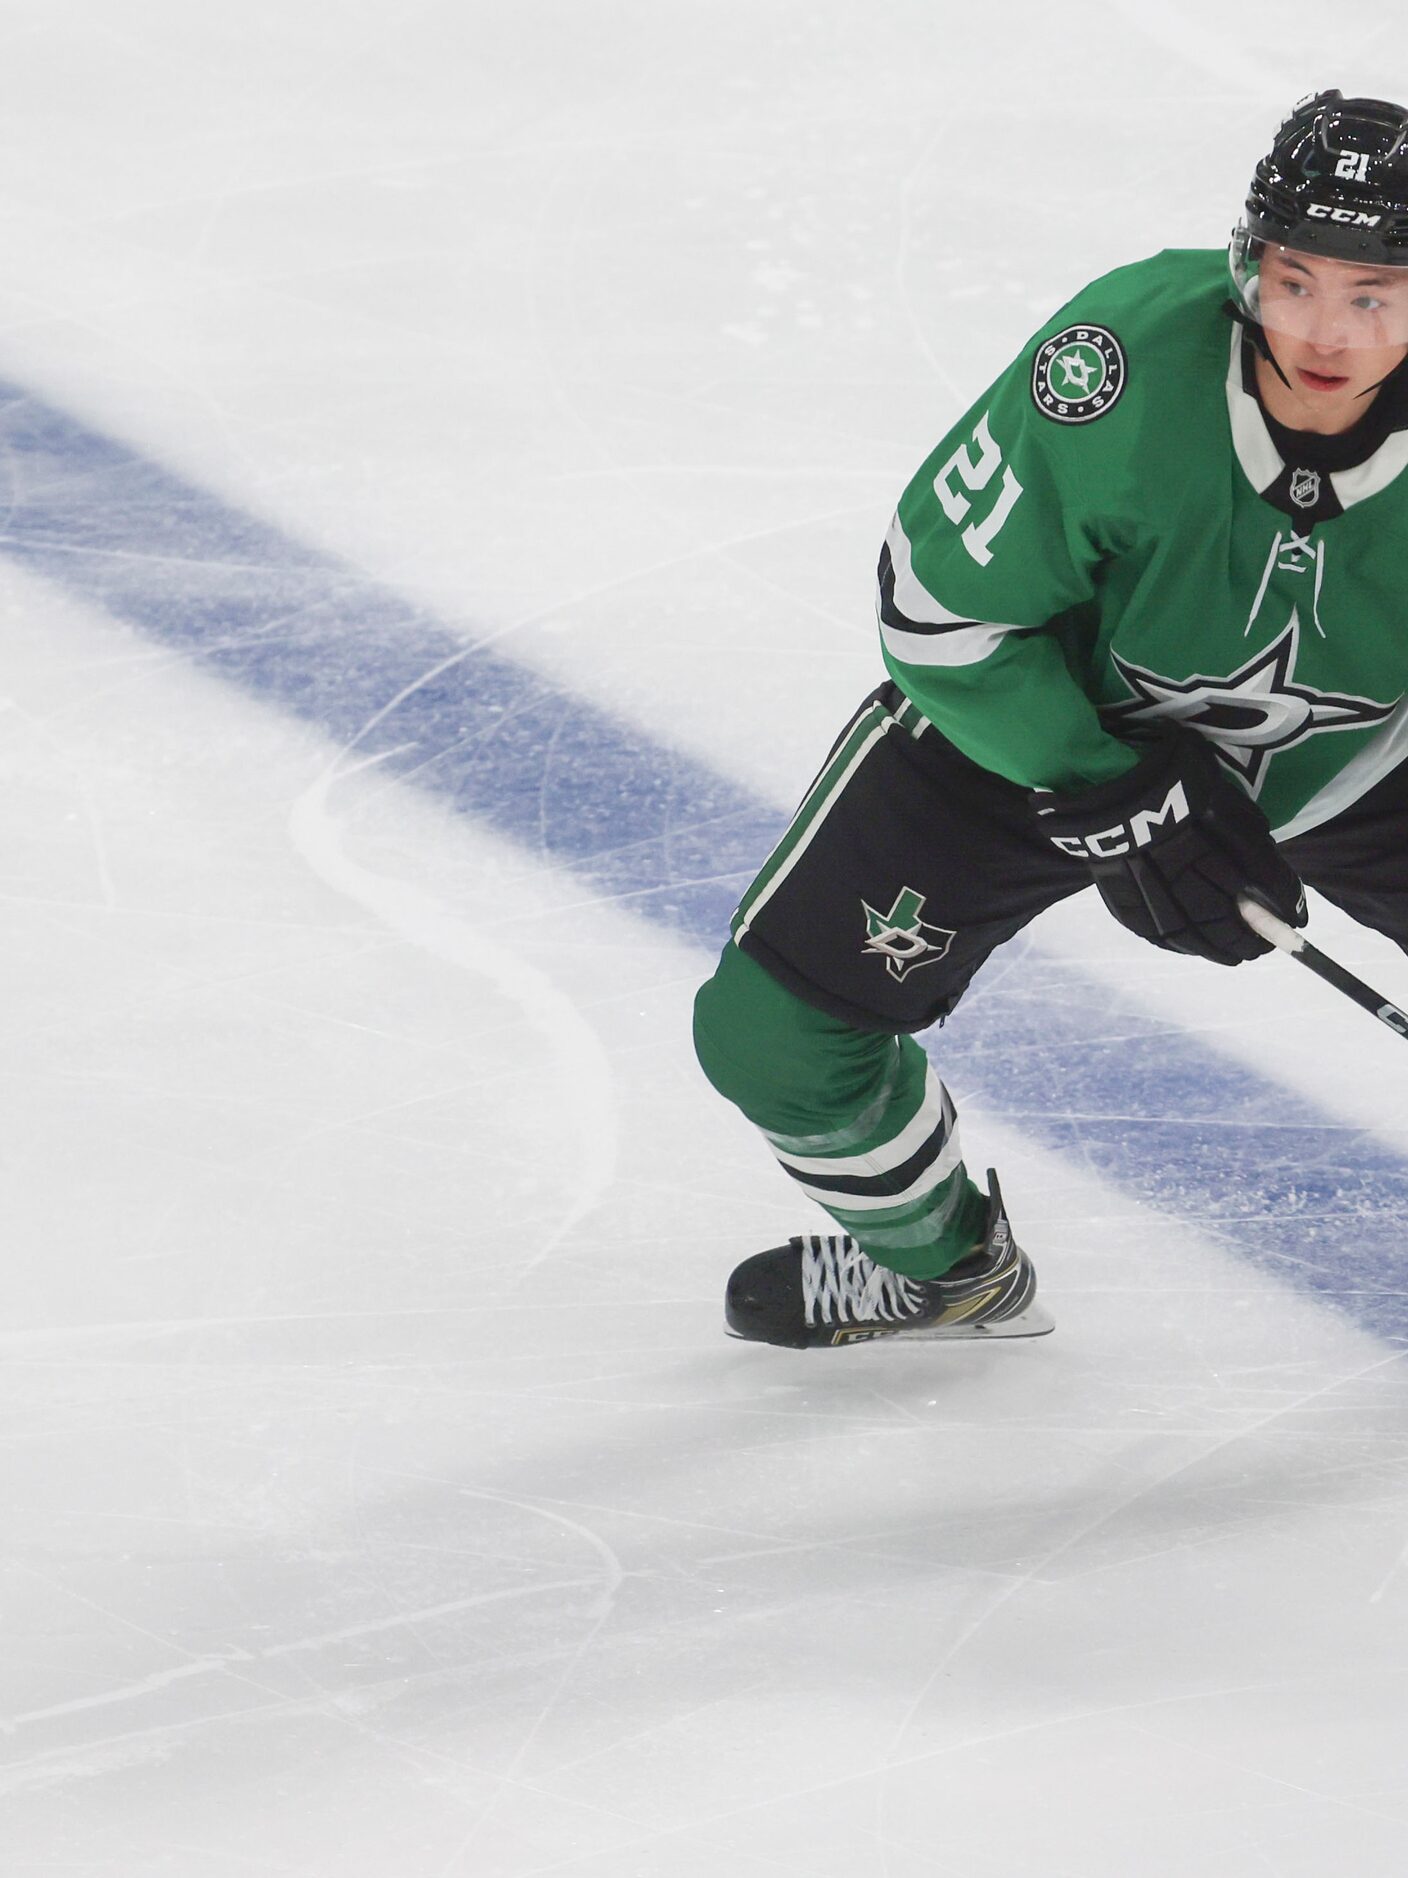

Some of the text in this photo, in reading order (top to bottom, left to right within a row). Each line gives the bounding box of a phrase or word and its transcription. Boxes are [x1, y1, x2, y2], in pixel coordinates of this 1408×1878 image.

[1335, 150, 1370, 183] 21
[1307, 203, 1381, 227] CCM
[1038, 345, 1069, 414] STARS
[1076, 331, 1118, 408] DALLAS
[933, 410, 1024, 567] 21
[1050, 780, 1190, 858] CCM
